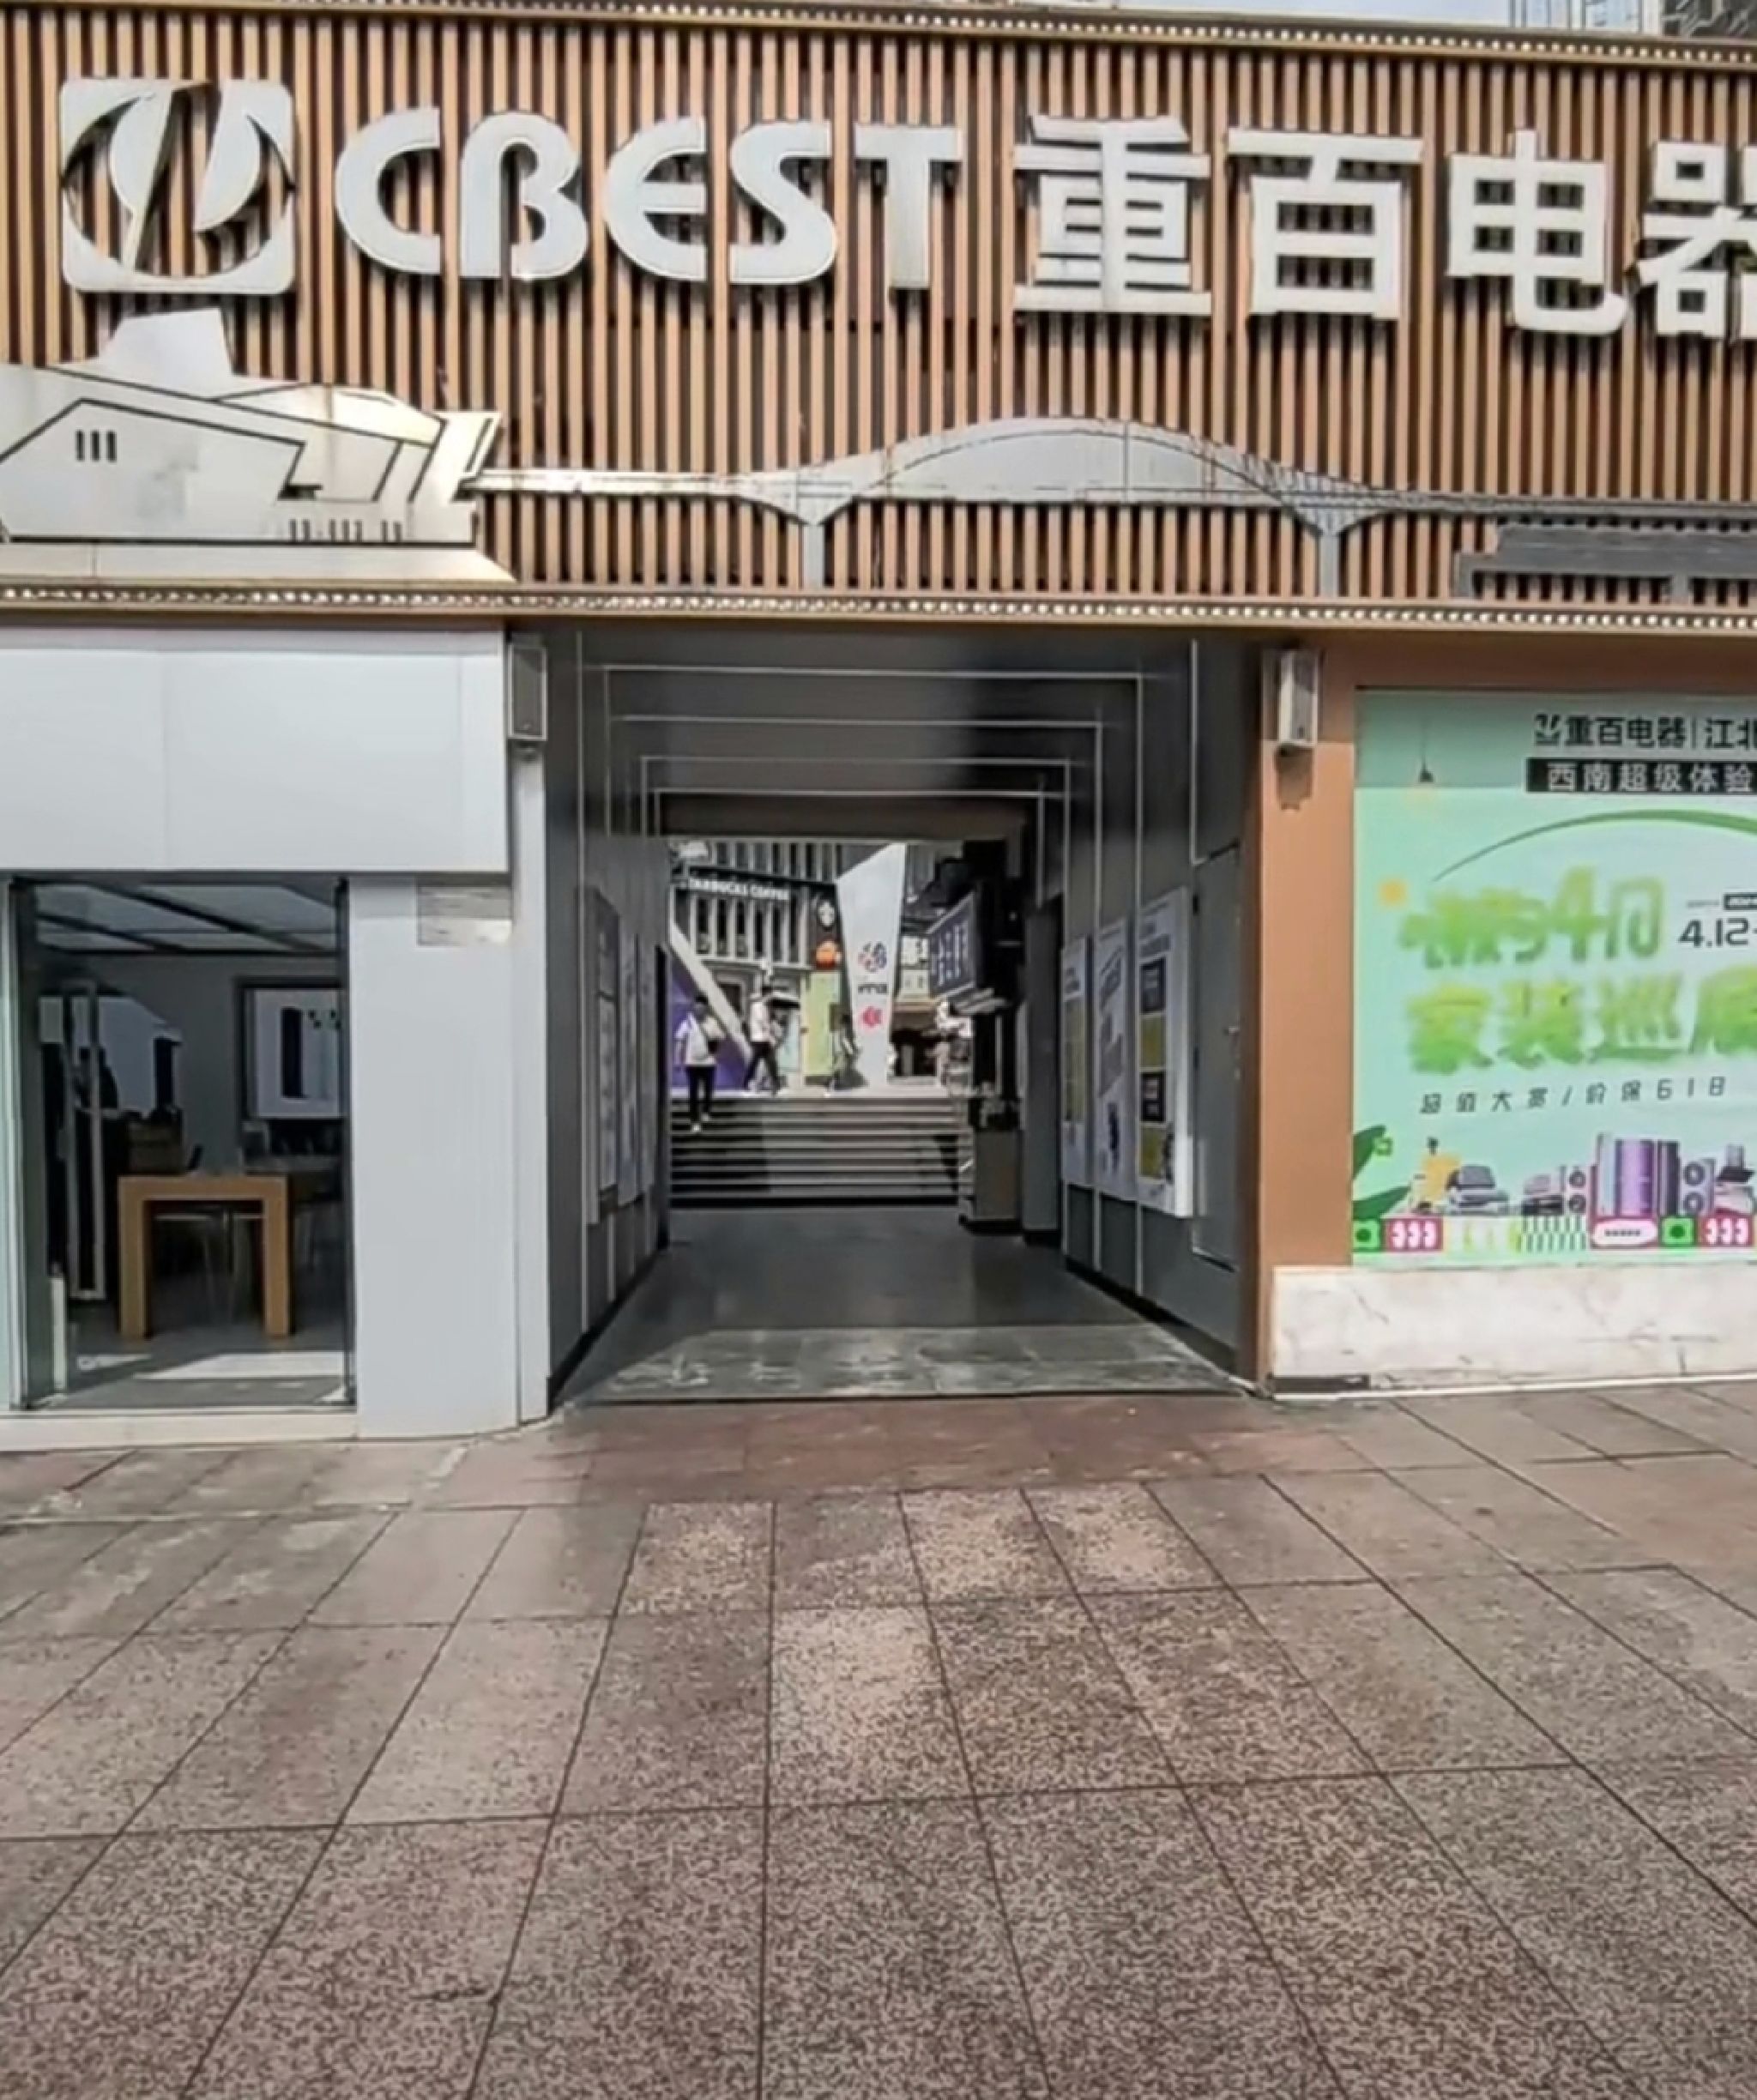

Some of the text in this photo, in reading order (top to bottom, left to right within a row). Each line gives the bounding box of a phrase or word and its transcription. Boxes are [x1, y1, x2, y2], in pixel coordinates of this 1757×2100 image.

[335, 106, 963, 290] CBEST
[1014, 114, 1757, 342] 重百电器
